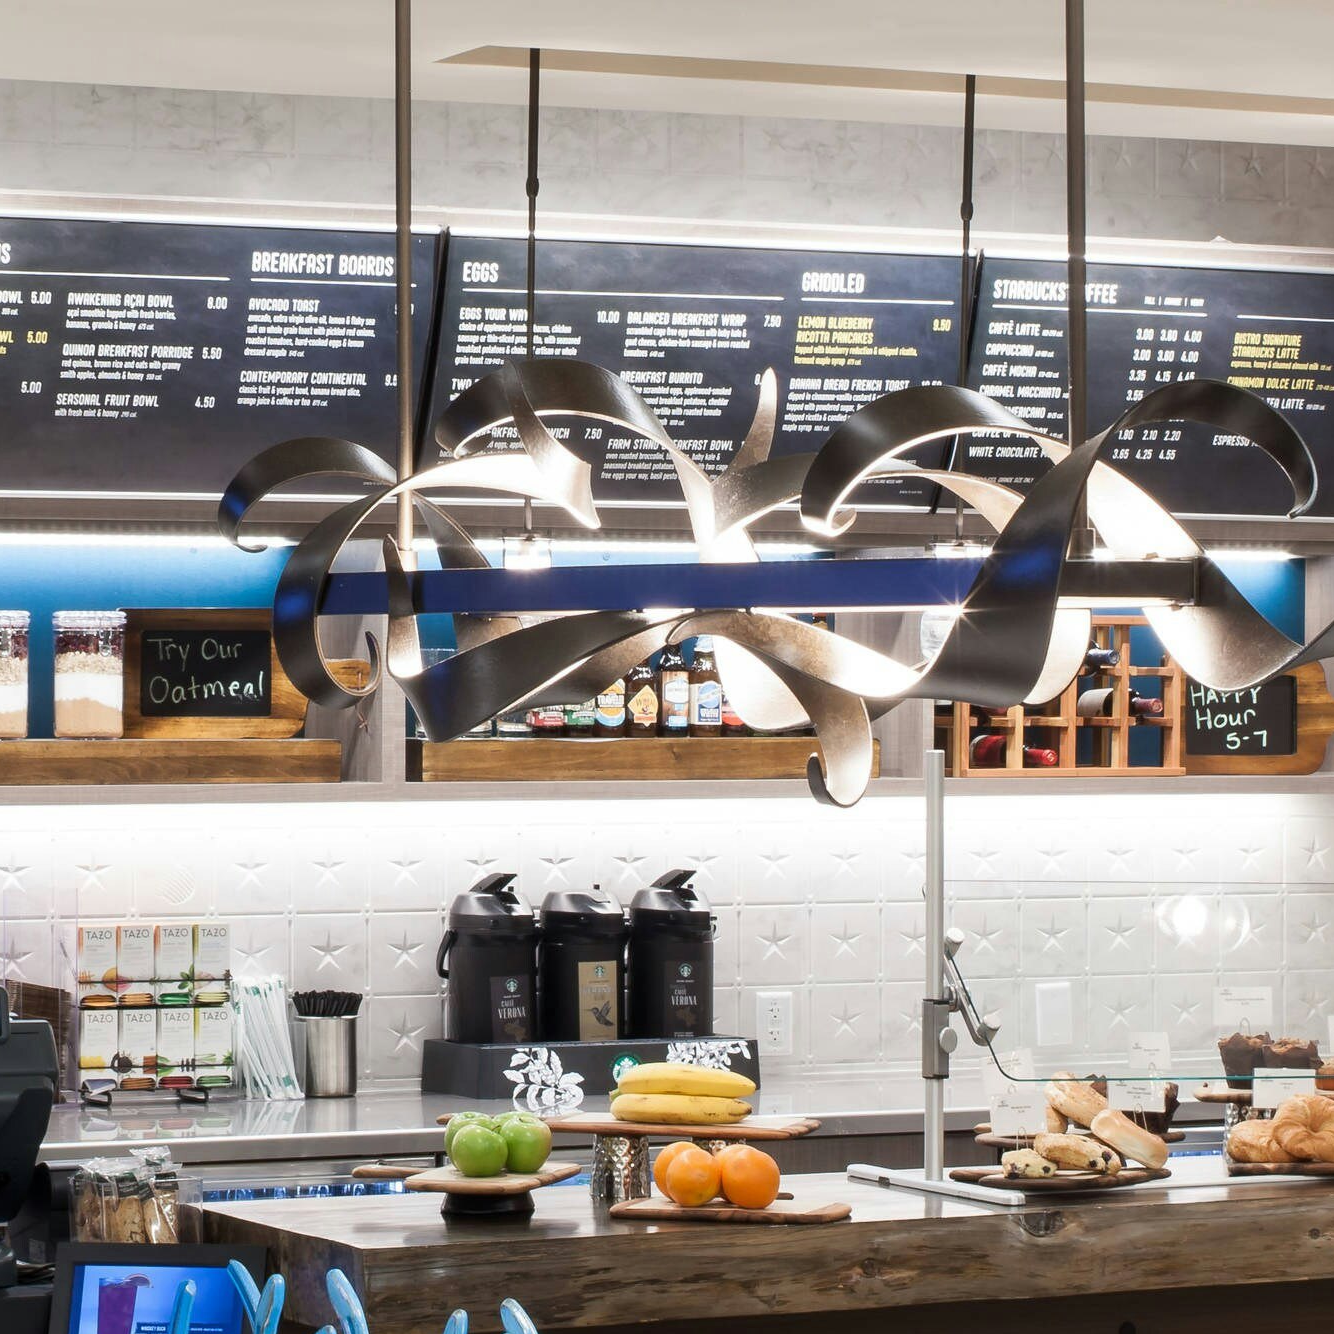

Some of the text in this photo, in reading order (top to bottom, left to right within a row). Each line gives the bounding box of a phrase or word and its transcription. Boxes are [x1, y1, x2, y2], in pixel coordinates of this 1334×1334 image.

[252, 251, 394, 276] BREAKFAST BOARDS
[463, 262, 499, 282] EGGS
[802, 272, 865, 293] GRIDDLED
[31, 291, 52, 304] 5.00
[993, 279, 1118, 304] STARBUCKS FFEE
[68, 292, 227, 309] AWAKENING AÇAI BOWL 8.00
[249, 298, 320, 313] AVOCADO TOAST
[460, 307, 482, 320] EGGS
[485, 308, 507, 321] YOUR
[597, 311, 620, 323] 10.00
[627, 312, 781, 327] BALANCED BREAKFAST WRAP 7.50
[798, 316, 826, 328] LEMON
[828, 317, 873, 330] BLUEBERRY
[1016, 324, 1041, 336] LATTE
[27, 331, 48, 343] 5.00
[796, 331, 873, 344] RICOTTA PANCAKES
[1234, 332, 1302, 346] BISTRO SIGNATURE
[63, 344, 222, 359] QUINOA BREAKFAST PORRIDGE 5.50
[986, 343, 1034, 356] CAPPUCCINO
[1232, 346, 1300, 359] STARBUCKS LATTE
[1181, 351, 1199, 363] 4.00
[1009, 365, 1037, 377] MOCHA
[1155, 371, 1171, 382] 4.15
[240, 370, 398, 386] CONTEMPORARY CONTINENTAL 9.5
[669, 373, 703, 384] BURRITO
[1266, 378, 1290, 389] DOLCE
[1291, 379, 1315, 390] LATTE
[21, 381, 42, 394] 5.00
[789, 378, 822, 390] BANANA
[823, 379, 849, 390] BREAD
[851, 379, 882, 391] FRENCH
[885, 380, 909, 391] TOAST
[1017, 386, 1062, 398] MACCHIATO
[56, 393, 215, 408] SEASONAL FRUIT BOWL 4.50
[1281, 398, 1305, 410] LATTE
[585, 429, 602, 439] 7.50
[1142, 430, 1158, 440] 2.10
[1164, 431, 1181, 441] 2.20
[607, 439, 631, 450] FARM
[710, 441, 733, 451] BOWL
[969, 446, 1039, 457] WHITE CHOCOLATE
[1135, 449, 1152, 459] 4.25
[1159, 449, 1176, 460] 4.55
[147, 638, 242, 672] Try Our
[150, 671, 263, 703] Oatmeal
[1196, 708, 1256, 729] Hour
[1226, 730, 1267, 749] 5-7
[86, 931, 112, 941] TAZO
[123, 929, 149, 939] TAZO
[163, 928, 188, 938] TAZO
[201, 928, 227, 937] TAZO
[671, 996, 697, 1006] VERONA
[87, 1014, 113, 1024] TAZO
[126, 1013, 152, 1023] TAZO
[163, 1012, 190, 1022] TAZO
[203, 1012, 228, 1021] TAZO
[498, 1007, 526, 1019] VERONA
